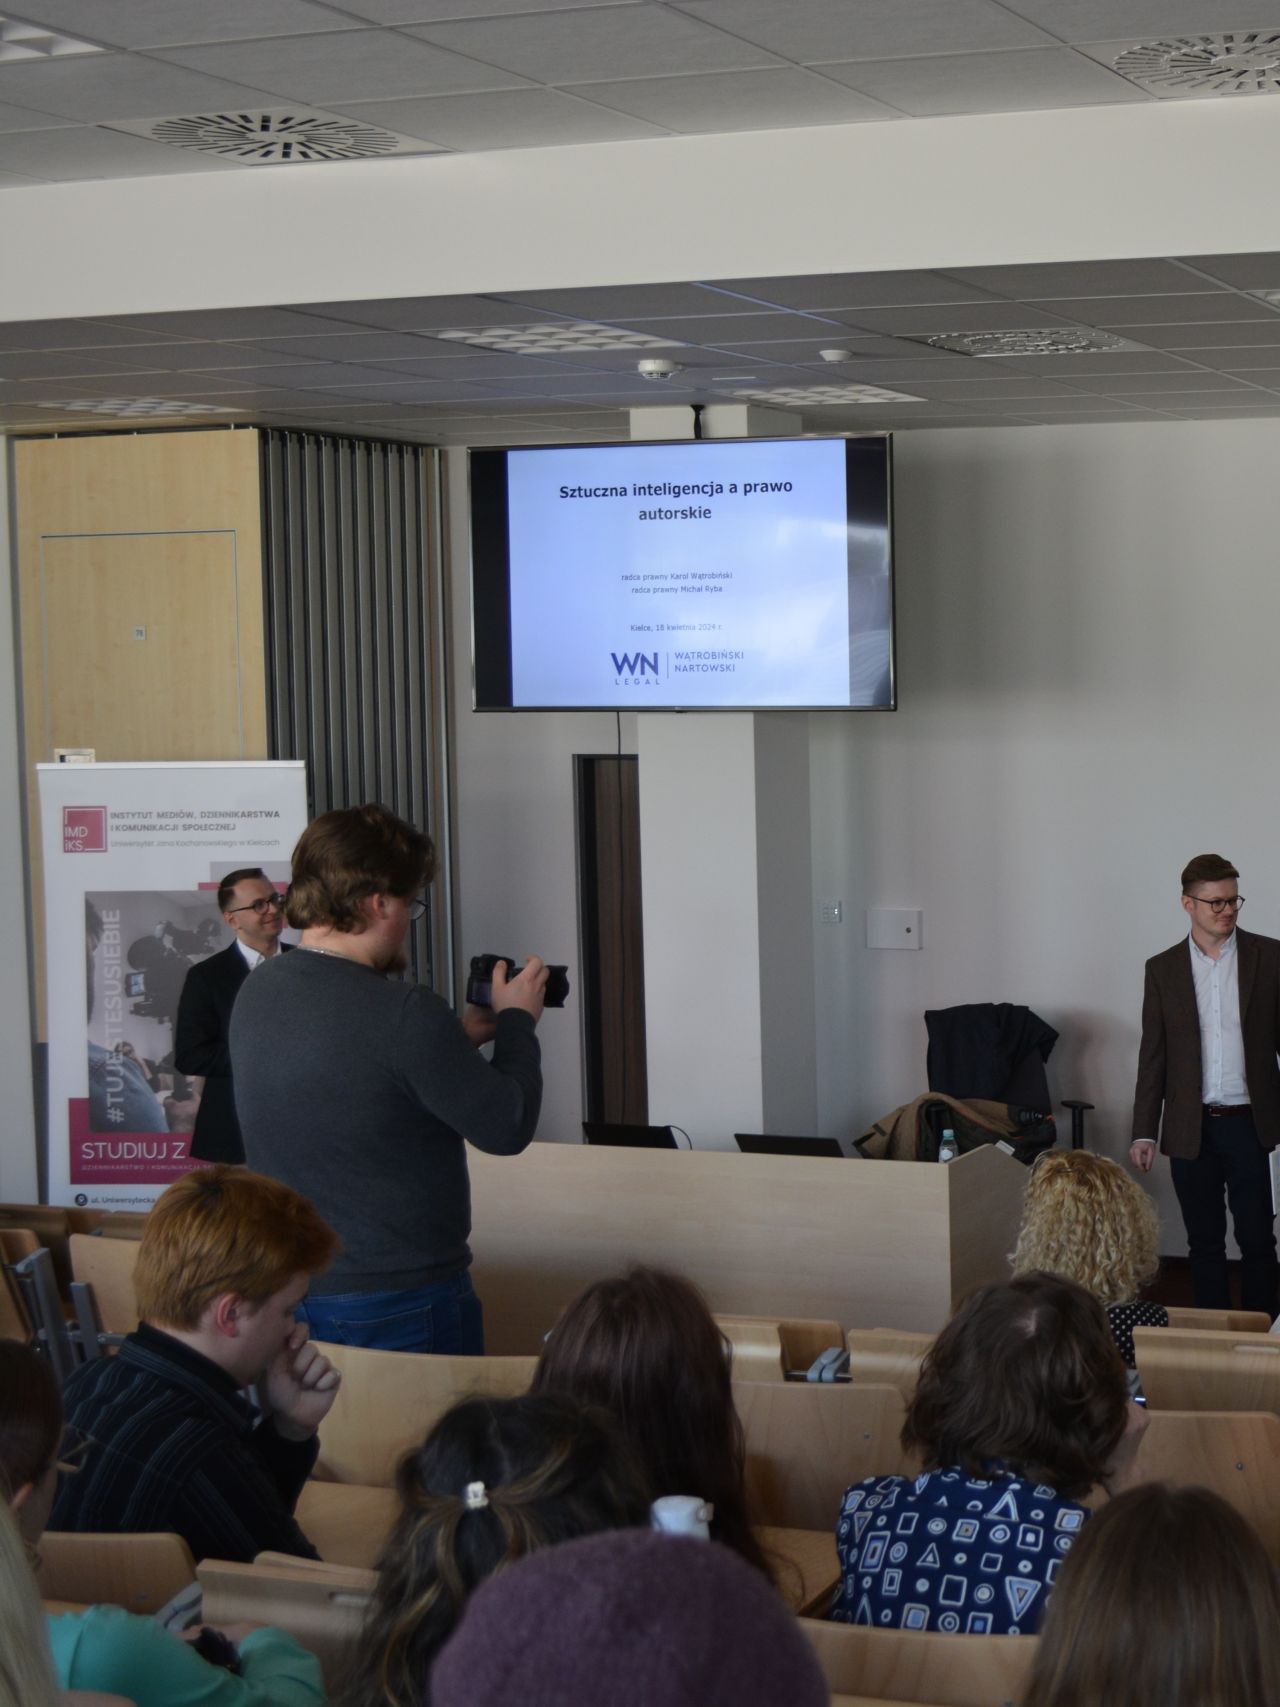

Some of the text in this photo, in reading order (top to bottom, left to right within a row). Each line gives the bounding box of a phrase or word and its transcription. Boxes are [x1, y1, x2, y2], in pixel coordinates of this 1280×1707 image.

[559, 480, 793, 498] Sztuczna inteligencja a prawo
[638, 506, 712, 521] autorskie
[643, 573, 668, 581] prawny
[631, 586, 651, 594] radca
[653, 586, 678, 594] prawny
[705, 585, 723, 593] Ryba
[610, 652, 659, 676] WN
[674, 664, 736, 672] NARTOWSKI
[110, 809, 281, 820] INSTYTUT MEDIÓW, DZIENNIKARSTWA
[64, 826, 88, 838] IMD
[115, 824, 179, 832] KOMUNIKACJI
[182, 823, 236, 832] SPOŁECZNEJ
[102, 909, 125, 1123] #TUJESTESUSIEBIE
[82, 1142, 186, 1159] STUDIUJ Z
